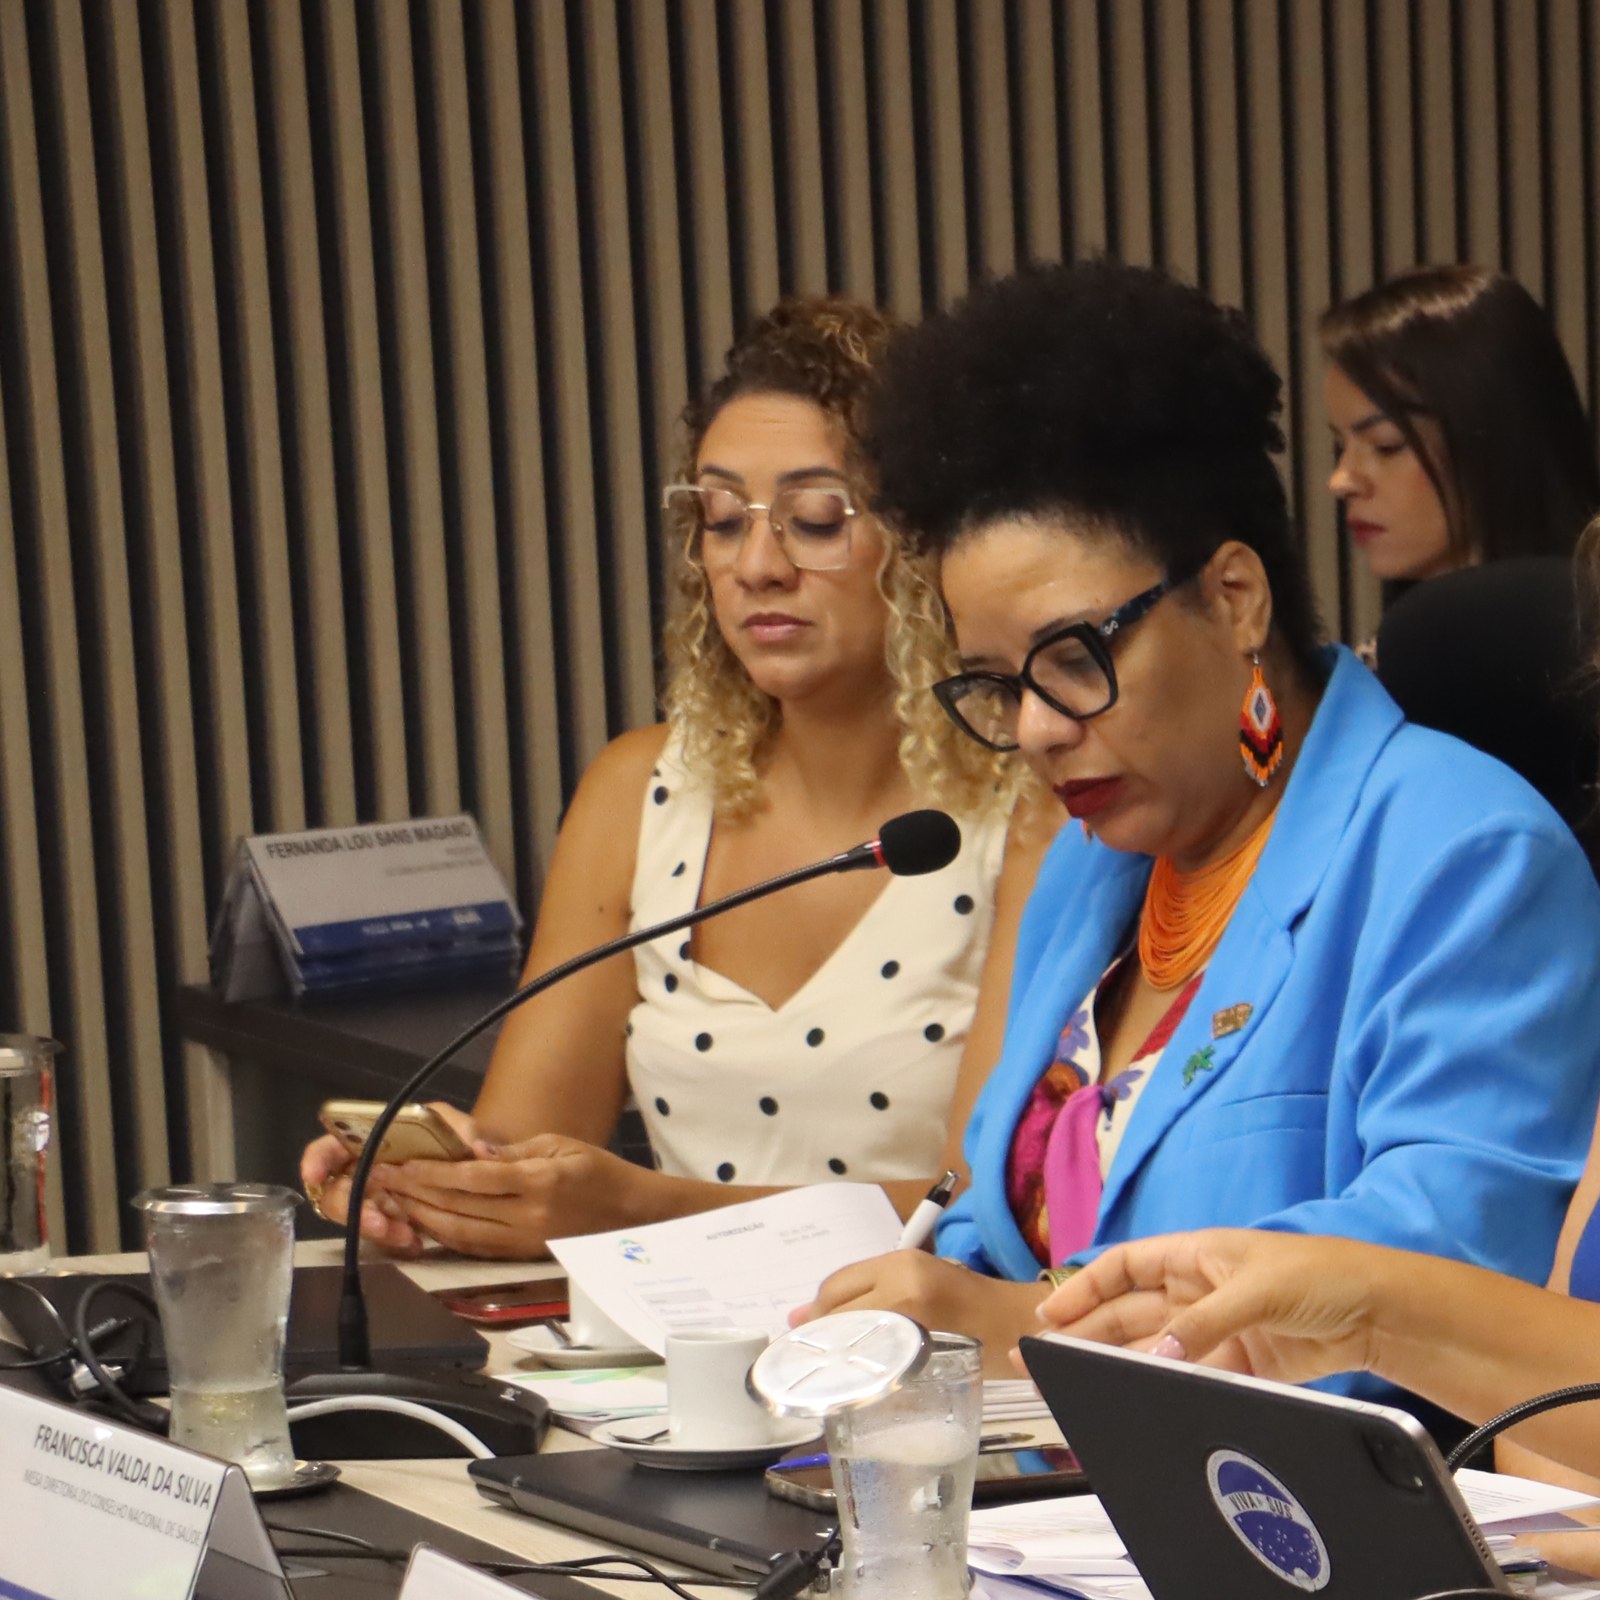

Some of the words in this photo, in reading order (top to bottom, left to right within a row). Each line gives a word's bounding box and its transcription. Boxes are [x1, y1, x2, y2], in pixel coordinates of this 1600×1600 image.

[266, 836, 343, 859] FERNANDA
[344, 832, 374, 851] LOU
[34, 1423, 106, 1472] FRANCISCA
[107, 1448, 152, 1488] VALDA
[152, 1466, 175, 1496] DA
[174, 1473, 213, 1510] SILVA
[90, 1492, 129, 1519] CONSELHO
[127, 1507, 164, 1533] NACIONAL
[1229, 1491, 1258, 1511] VIVA
[1266, 1495, 1293, 1520] SUS
